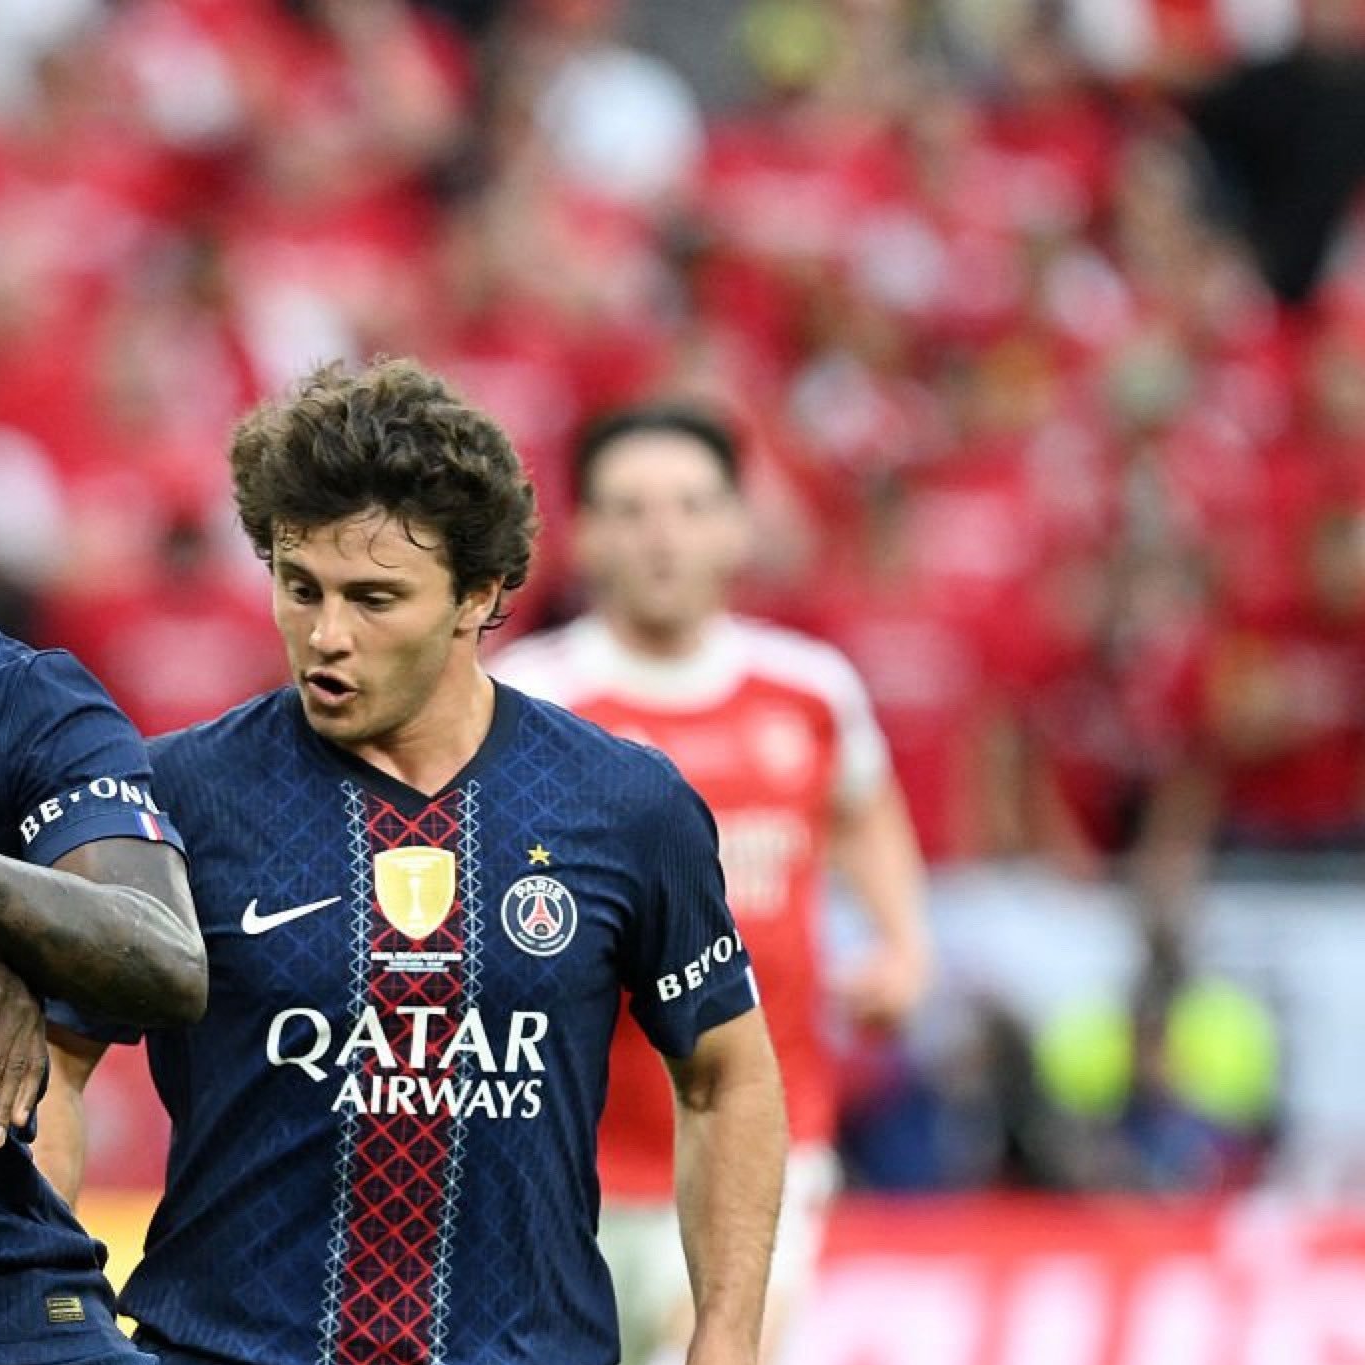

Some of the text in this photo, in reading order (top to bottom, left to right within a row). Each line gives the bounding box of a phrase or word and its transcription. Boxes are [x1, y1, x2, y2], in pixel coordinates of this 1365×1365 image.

[514, 880, 567, 901] PARIS
[265, 1004, 549, 1082] QATAR
[331, 1074, 543, 1119] AIRWAYS
